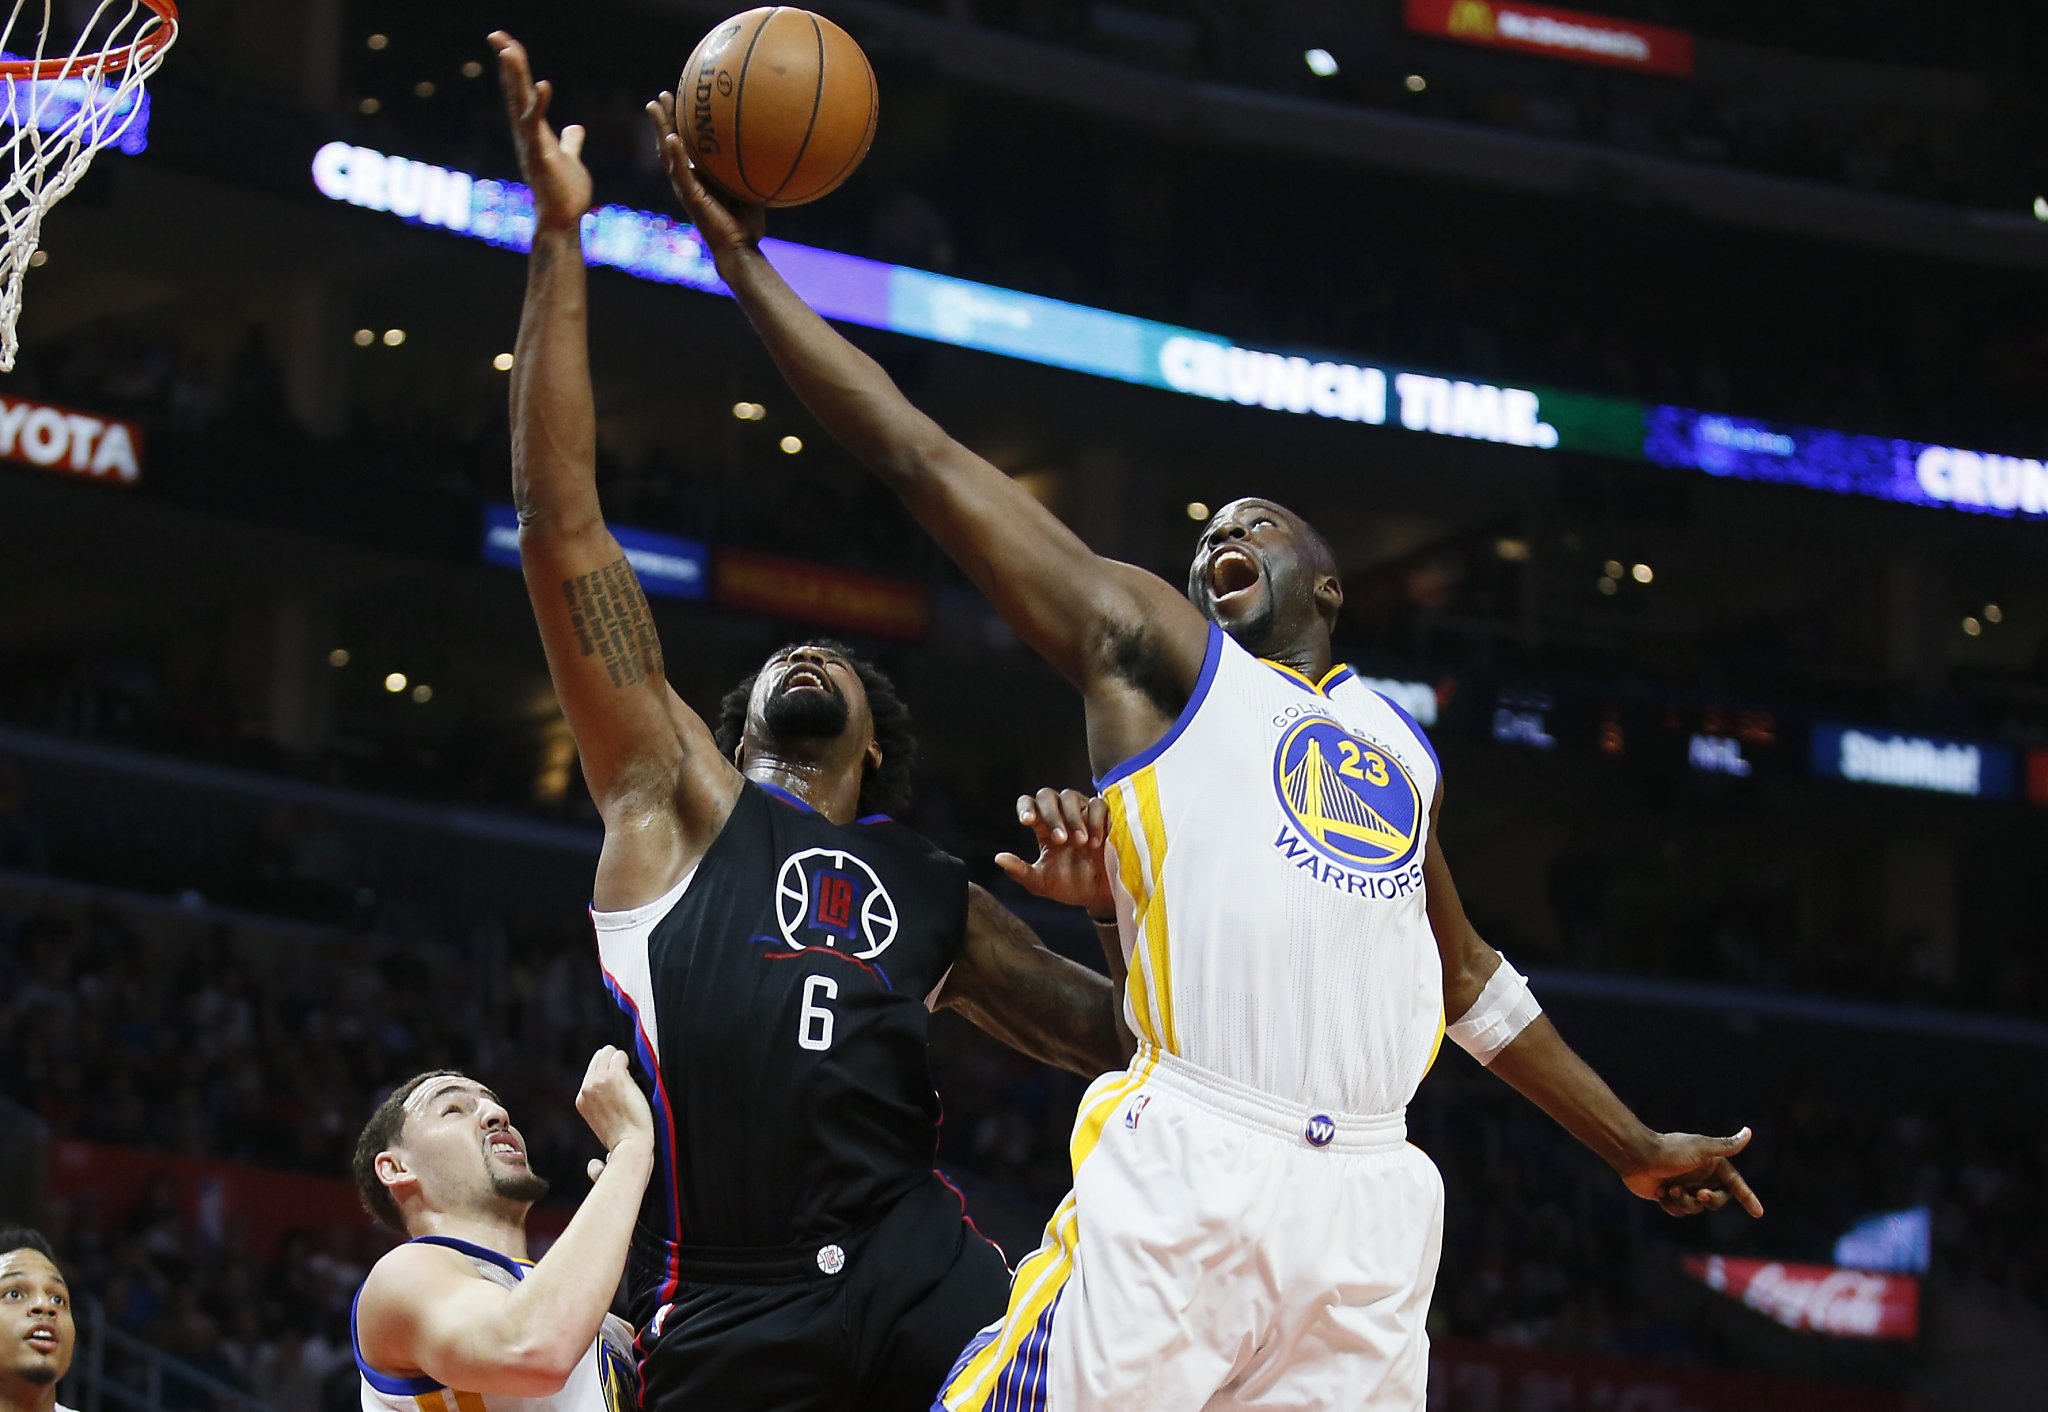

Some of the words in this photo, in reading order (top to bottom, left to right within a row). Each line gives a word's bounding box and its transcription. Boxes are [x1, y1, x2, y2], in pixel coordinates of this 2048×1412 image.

[1159, 336, 1387, 425] CRUNCH
[1395, 372, 1559, 449] TIME.
[1337, 740, 1390, 787] 23
[1274, 825, 1422, 899] WARRIORS
[798, 975, 838, 1051] 6
